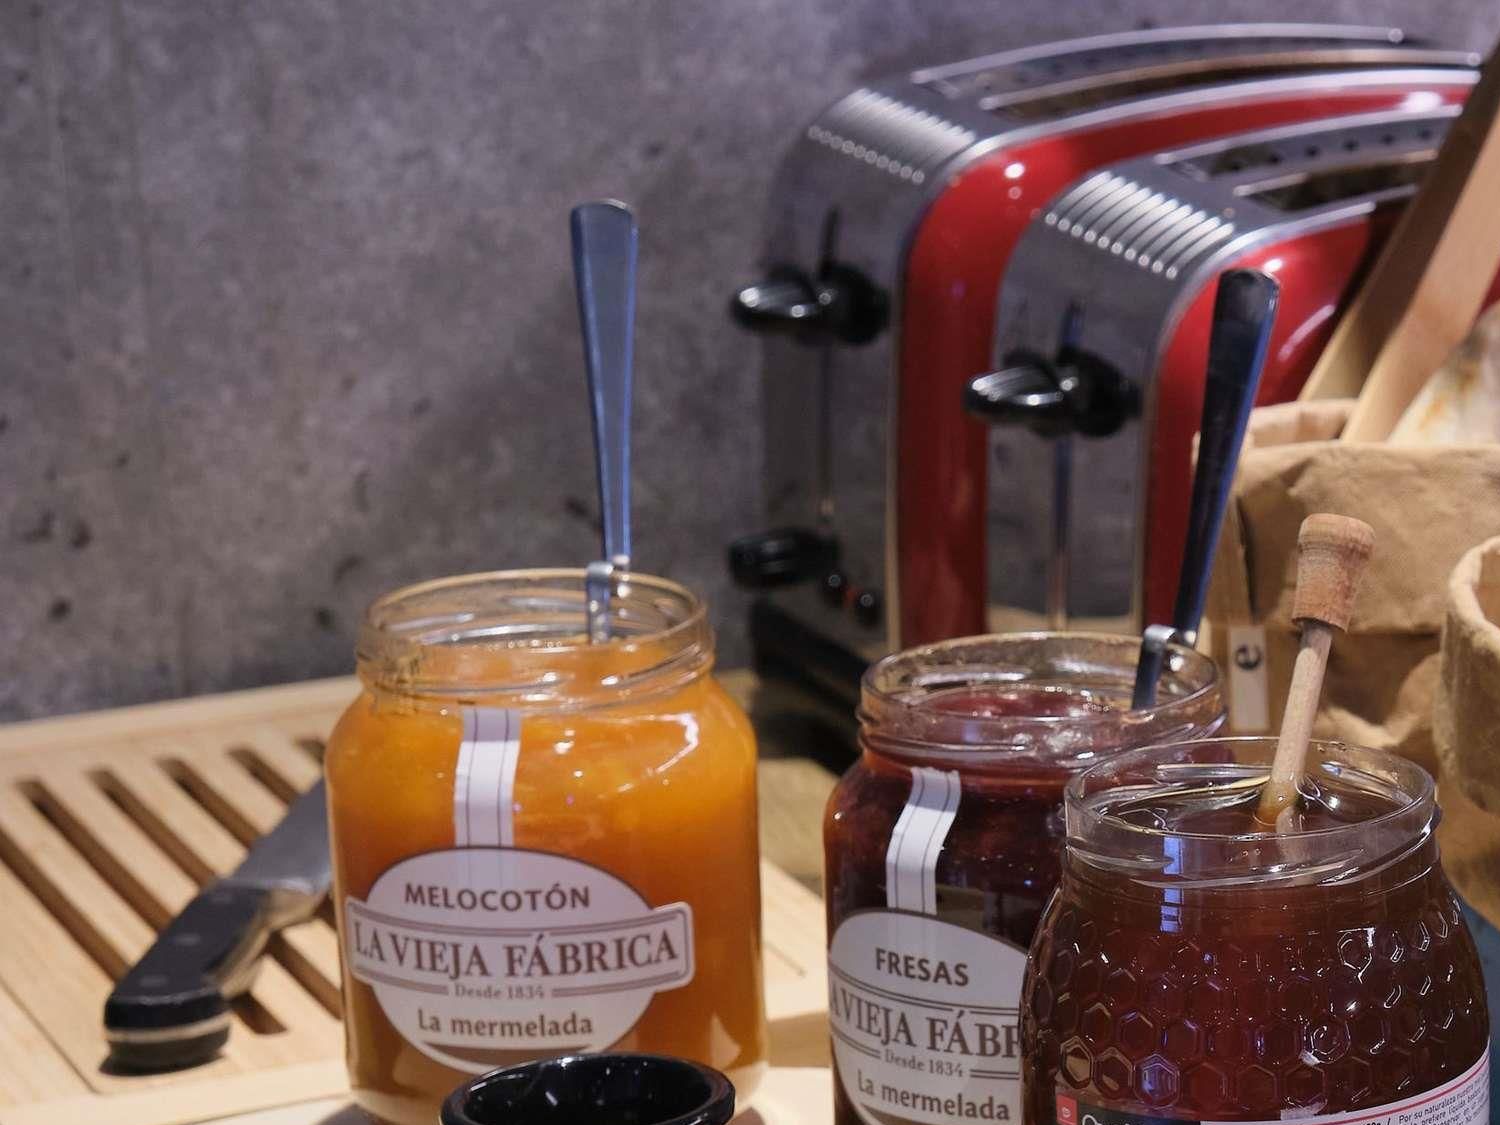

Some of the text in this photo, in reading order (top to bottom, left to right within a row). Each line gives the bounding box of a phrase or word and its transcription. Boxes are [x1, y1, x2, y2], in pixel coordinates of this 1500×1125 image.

[405, 882, 589, 912] MELOCOTÓN
[355, 922, 678, 979] LA VIEJA FÁBRICA
[876, 948, 969, 986] FRESAS
[454, 984, 544, 999] Desde 1834
[417, 1009, 592, 1037] La mermelada
[840, 987, 917, 1046] VIEJA
[885, 1049, 964, 1077] Desde 1834
[858, 1068, 1010, 1120] La mermelada
